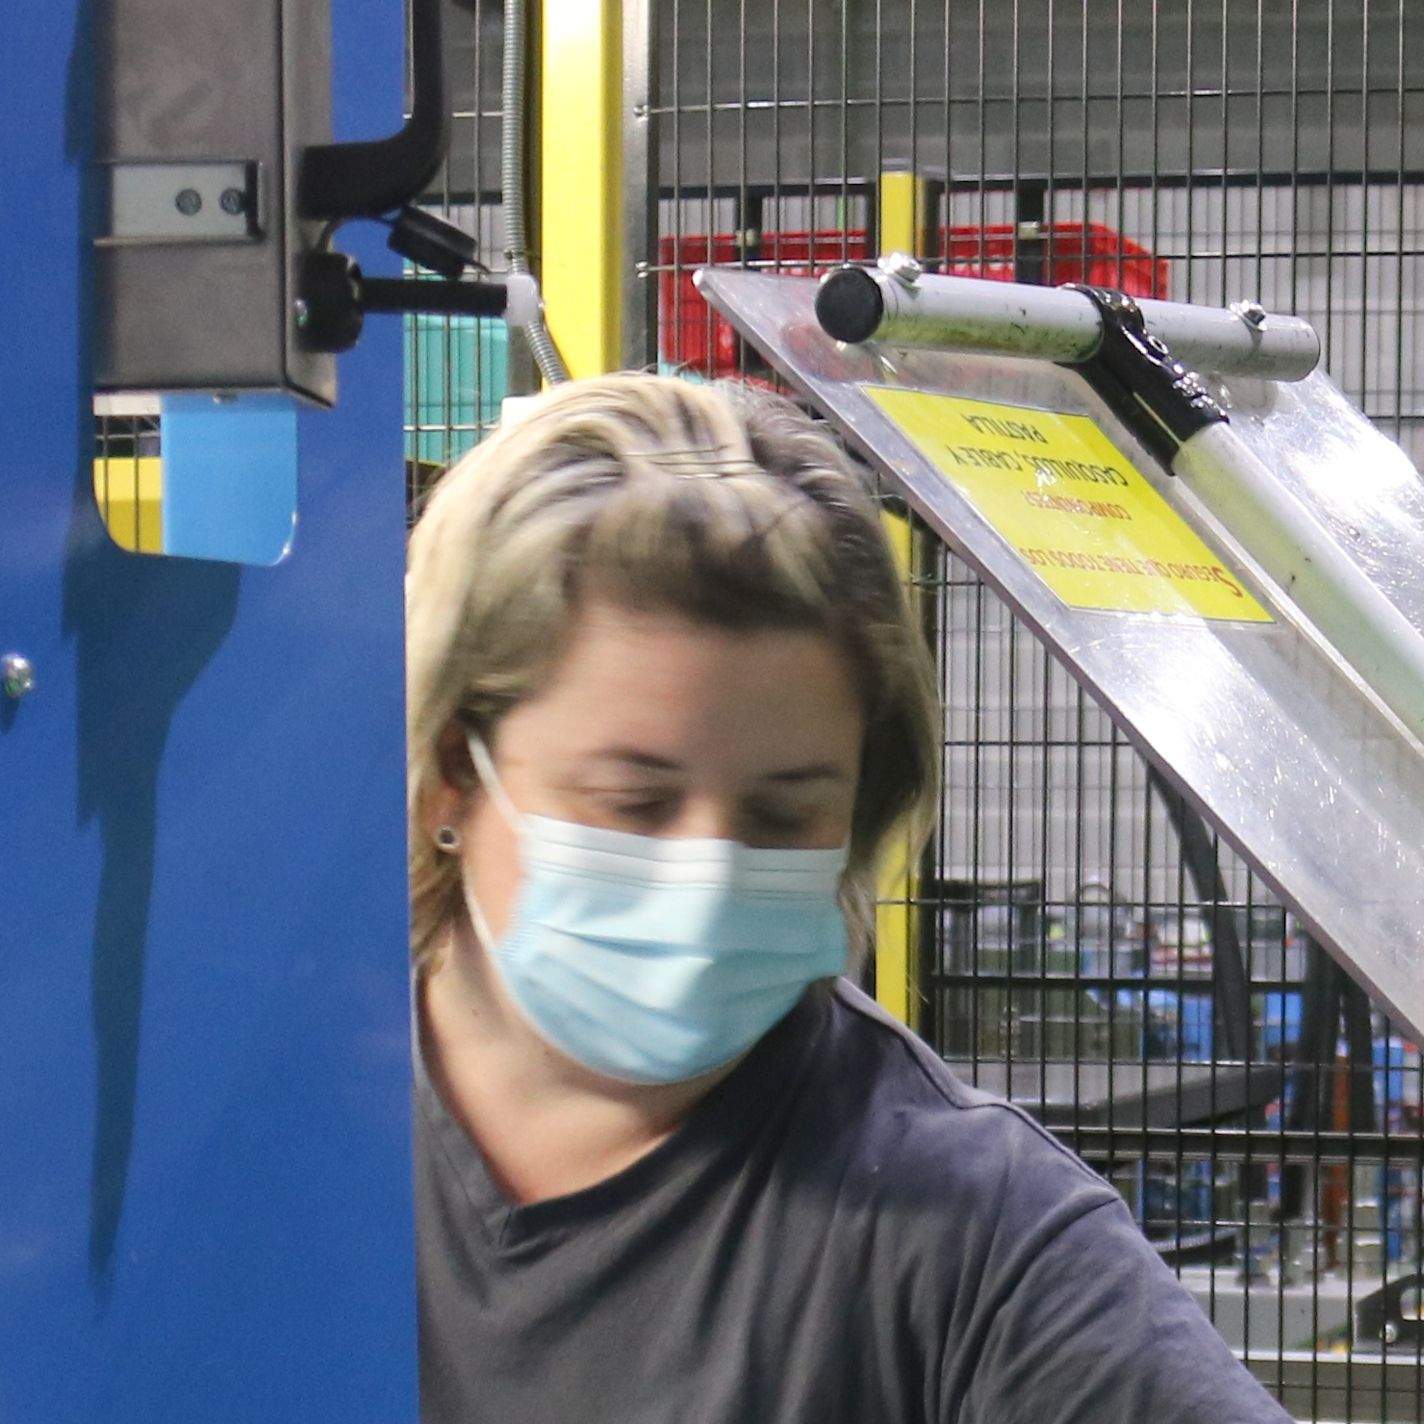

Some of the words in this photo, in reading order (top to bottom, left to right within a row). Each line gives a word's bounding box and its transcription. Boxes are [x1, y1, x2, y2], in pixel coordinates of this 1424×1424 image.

[961, 413, 1048, 444] PASTILLA
[945, 444, 967, 466] Y
[957, 446, 1024, 472] CABLE
[1018, 547, 1056, 567] LOS
[1046, 551, 1105, 571] TODOS
